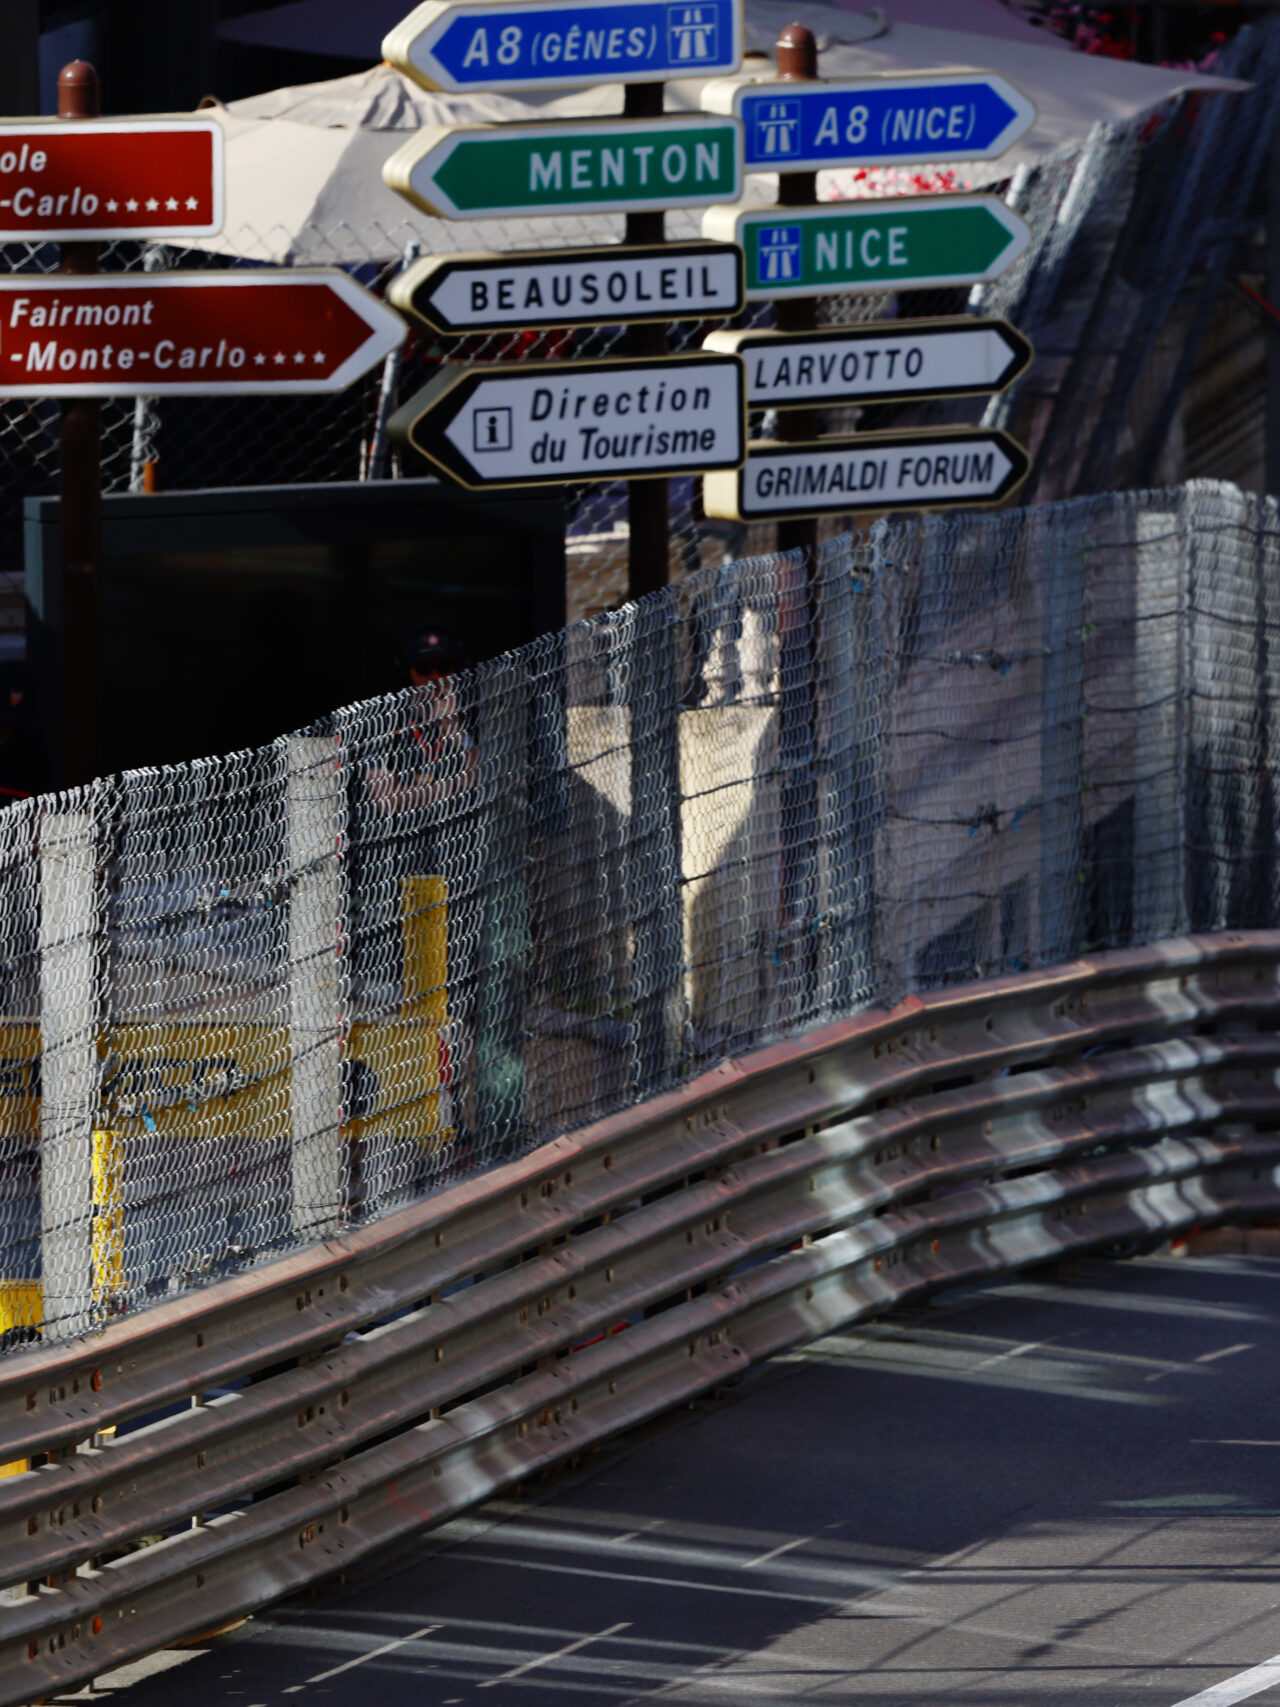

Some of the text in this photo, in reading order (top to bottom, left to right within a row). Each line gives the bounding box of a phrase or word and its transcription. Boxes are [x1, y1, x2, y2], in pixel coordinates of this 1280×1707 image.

[462, 25, 657, 68] A8 (GÊNES)
[814, 103, 975, 146] A8 (NICE)
[530, 142, 720, 191] MENTON
[815, 226, 909, 272] NICE
[470, 266, 718, 312] BEAUSOLEIL
[10, 299, 154, 328] Fairmont
[754, 348, 923, 389] LARVOTTO
[530, 382, 710, 422] Direction
[530, 425, 715, 464] du Tourisme
[755, 453, 994, 498] GRIMALDI FORUM
